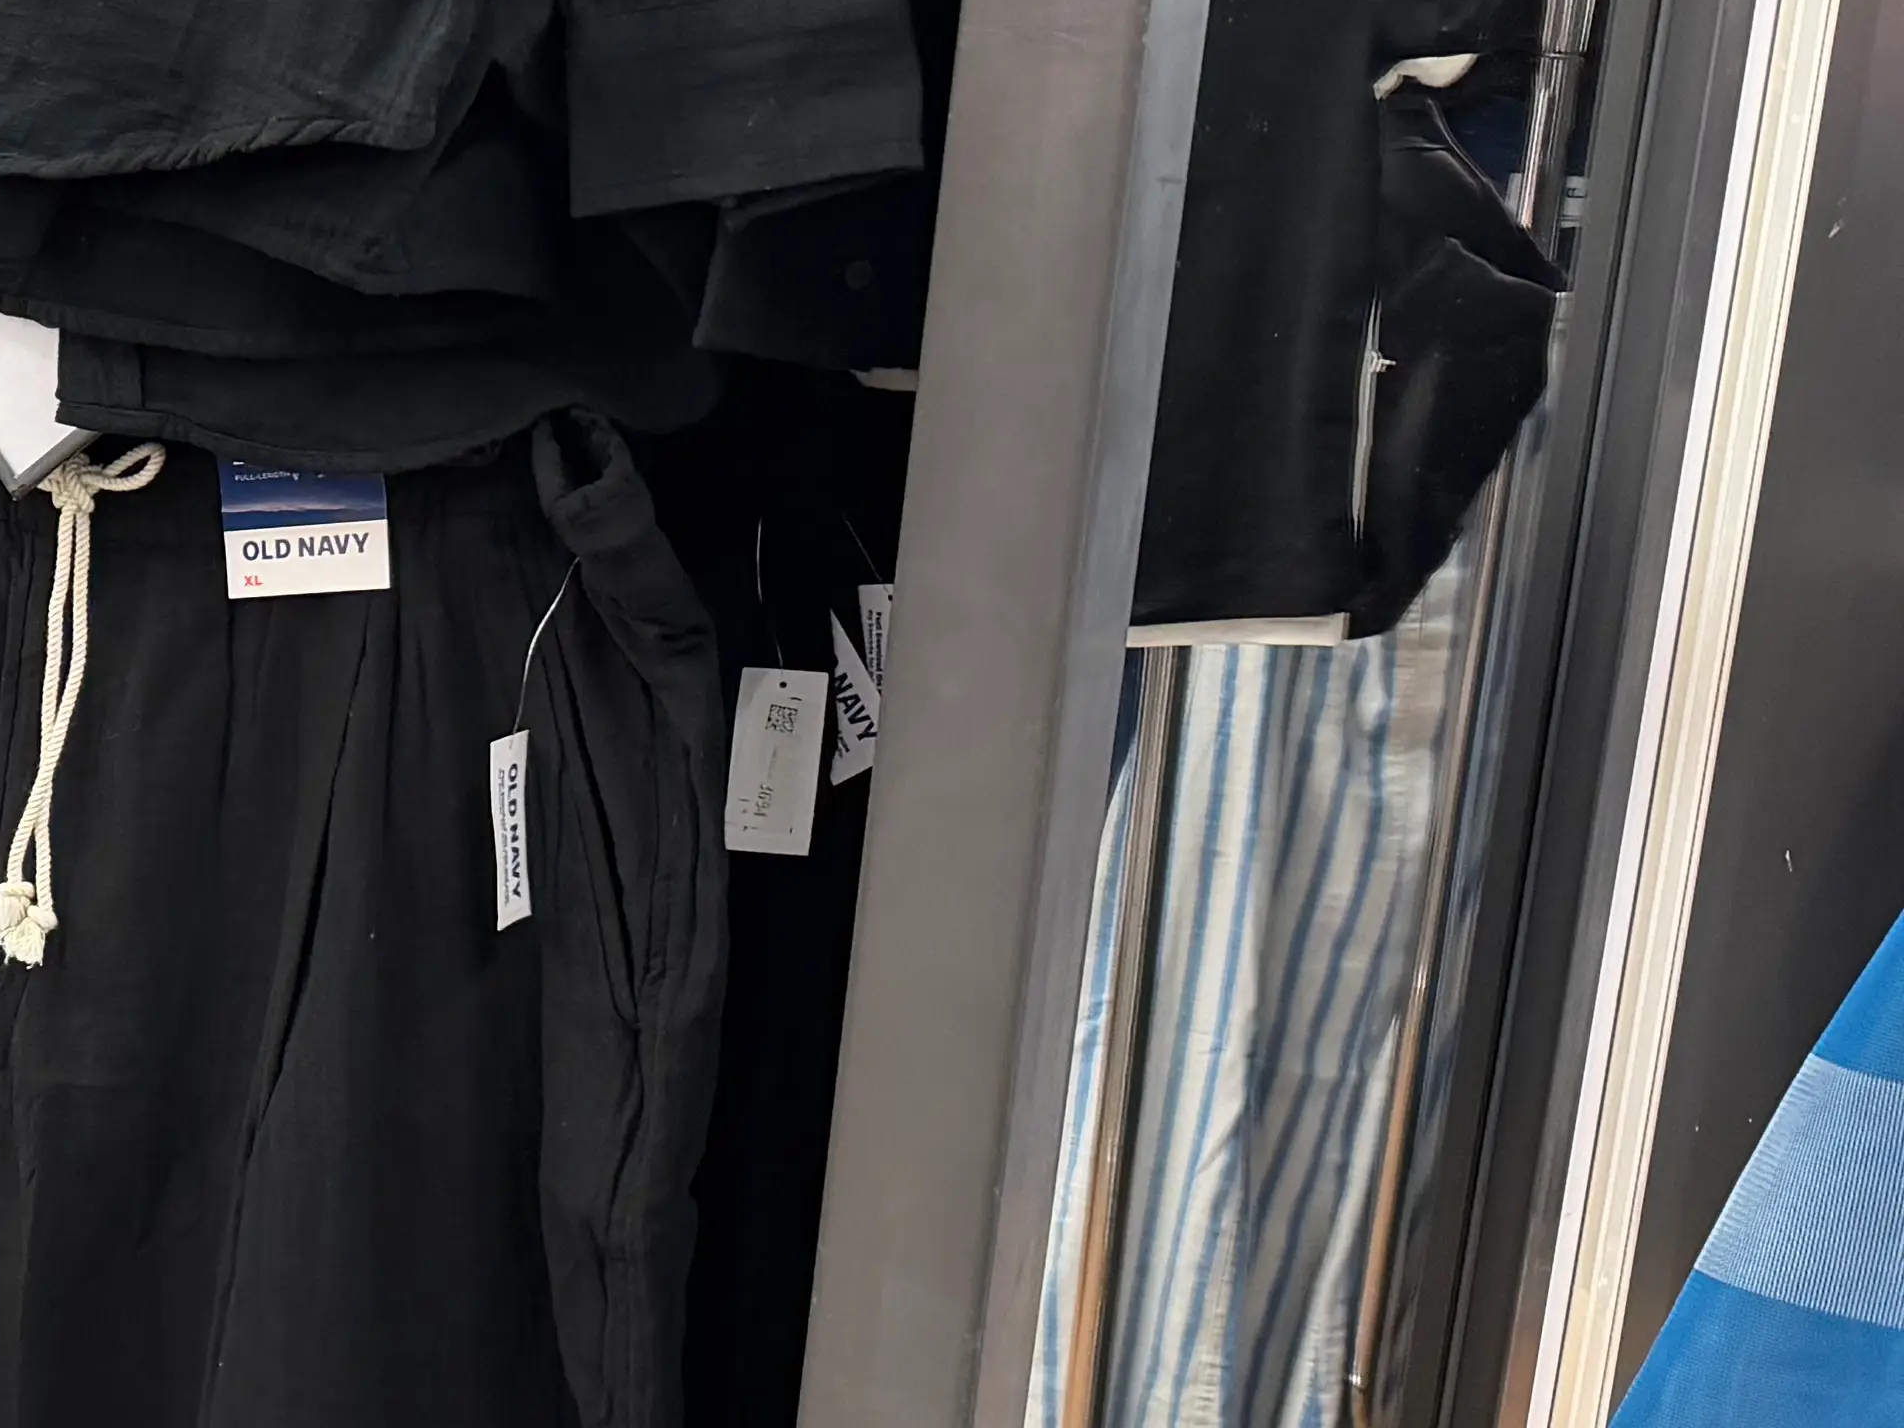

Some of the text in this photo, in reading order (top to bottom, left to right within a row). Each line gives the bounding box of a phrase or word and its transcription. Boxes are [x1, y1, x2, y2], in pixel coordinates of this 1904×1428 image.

[243, 532, 369, 561] OLD NAVY
[244, 575, 263, 587] XL
[834, 673, 877, 741] NAVY
[508, 763, 521, 898] OLD NAVY
